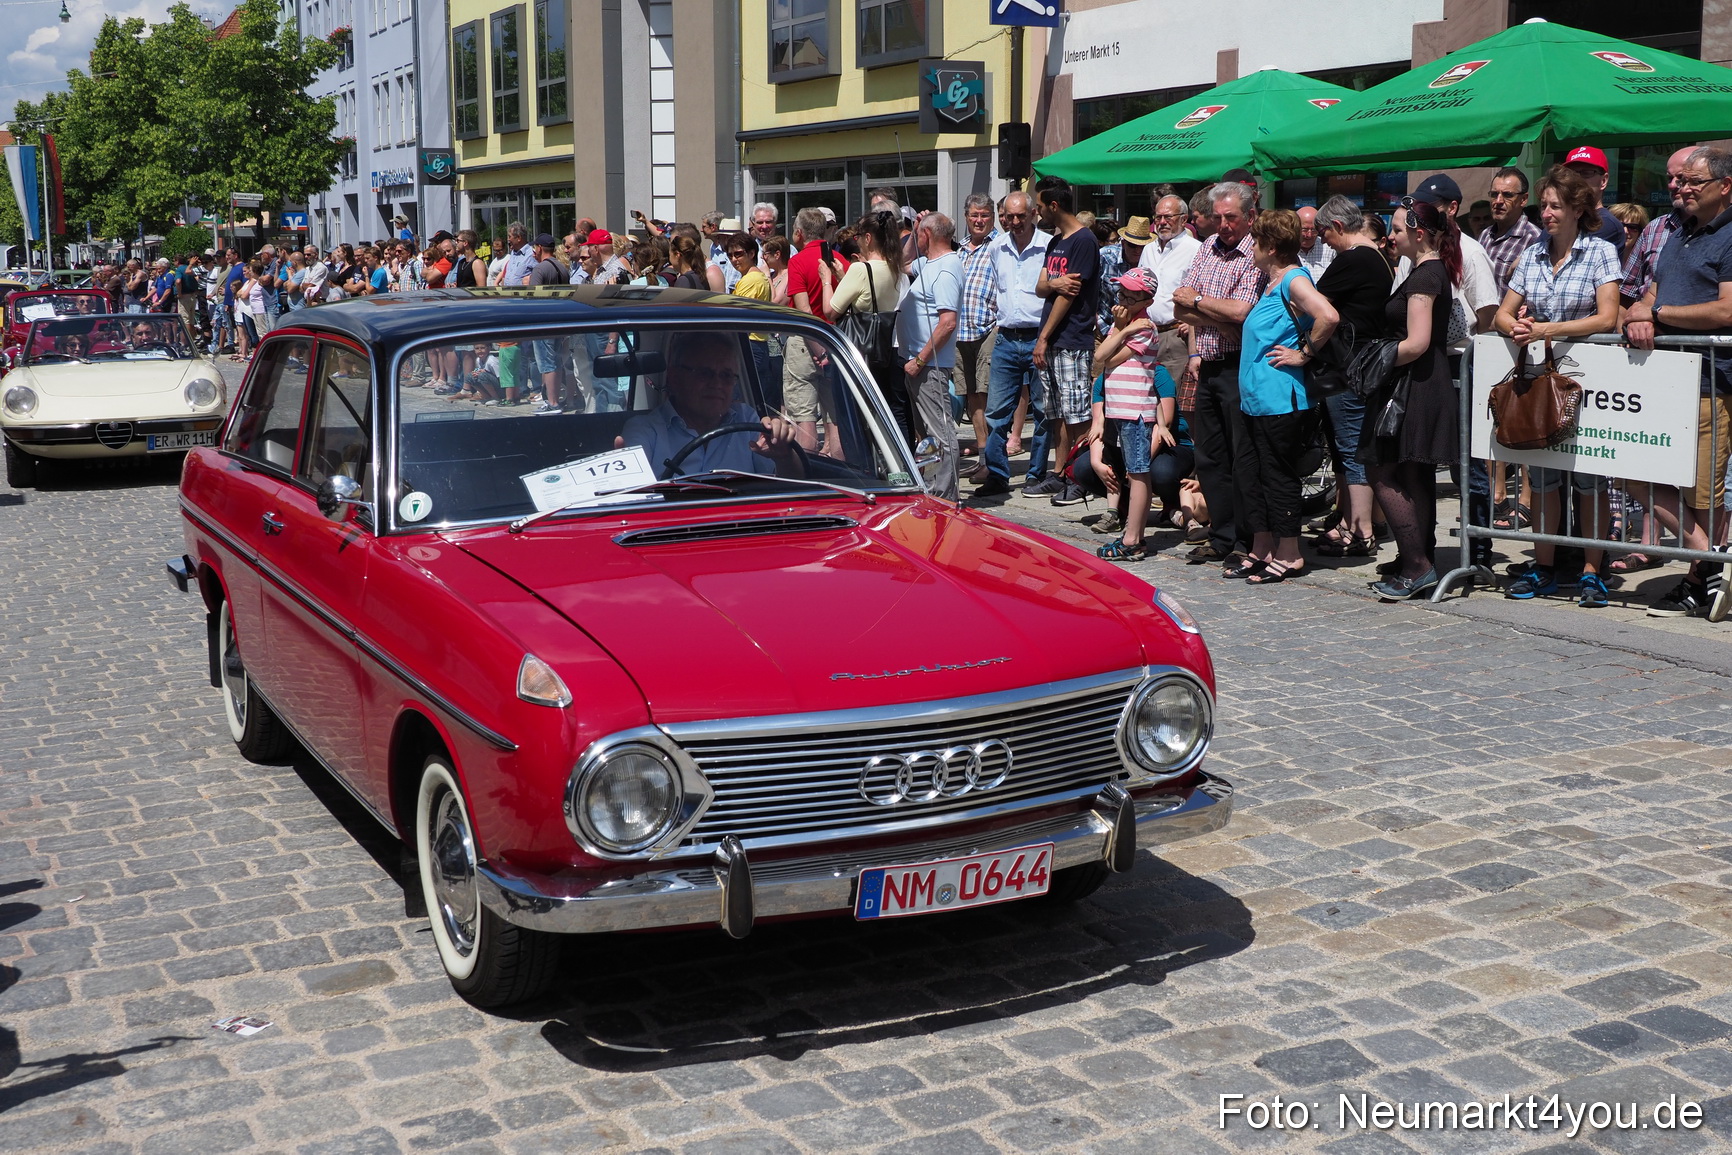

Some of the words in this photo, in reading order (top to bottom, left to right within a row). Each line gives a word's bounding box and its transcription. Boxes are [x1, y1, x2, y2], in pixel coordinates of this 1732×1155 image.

[1065, 49, 1089, 64] Unterer
[1090, 44, 1110, 60] Markt
[1112, 41, 1120, 56] 15
[947, 80, 969, 110] G2
[1380, 87, 1475, 106] Neumarkter
[1345, 96, 1474, 121] Lammsbräu
[1106, 138, 1204, 153] Lammsbräu
[1135, 131, 1206, 141] Neumarkter
[432, 158, 445, 173] G2
[1580, 388, 1642, 414] ress
[155, 435, 169, 447] ER
[176, 434, 190, 446] WR
[192, 431, 213, 445] 11H
[585, 459, 628, 478] 173
[864, 898, 874, 910] D
[882, 869, 937, 911] NM
[959, 850, 1048, 901] 0644
